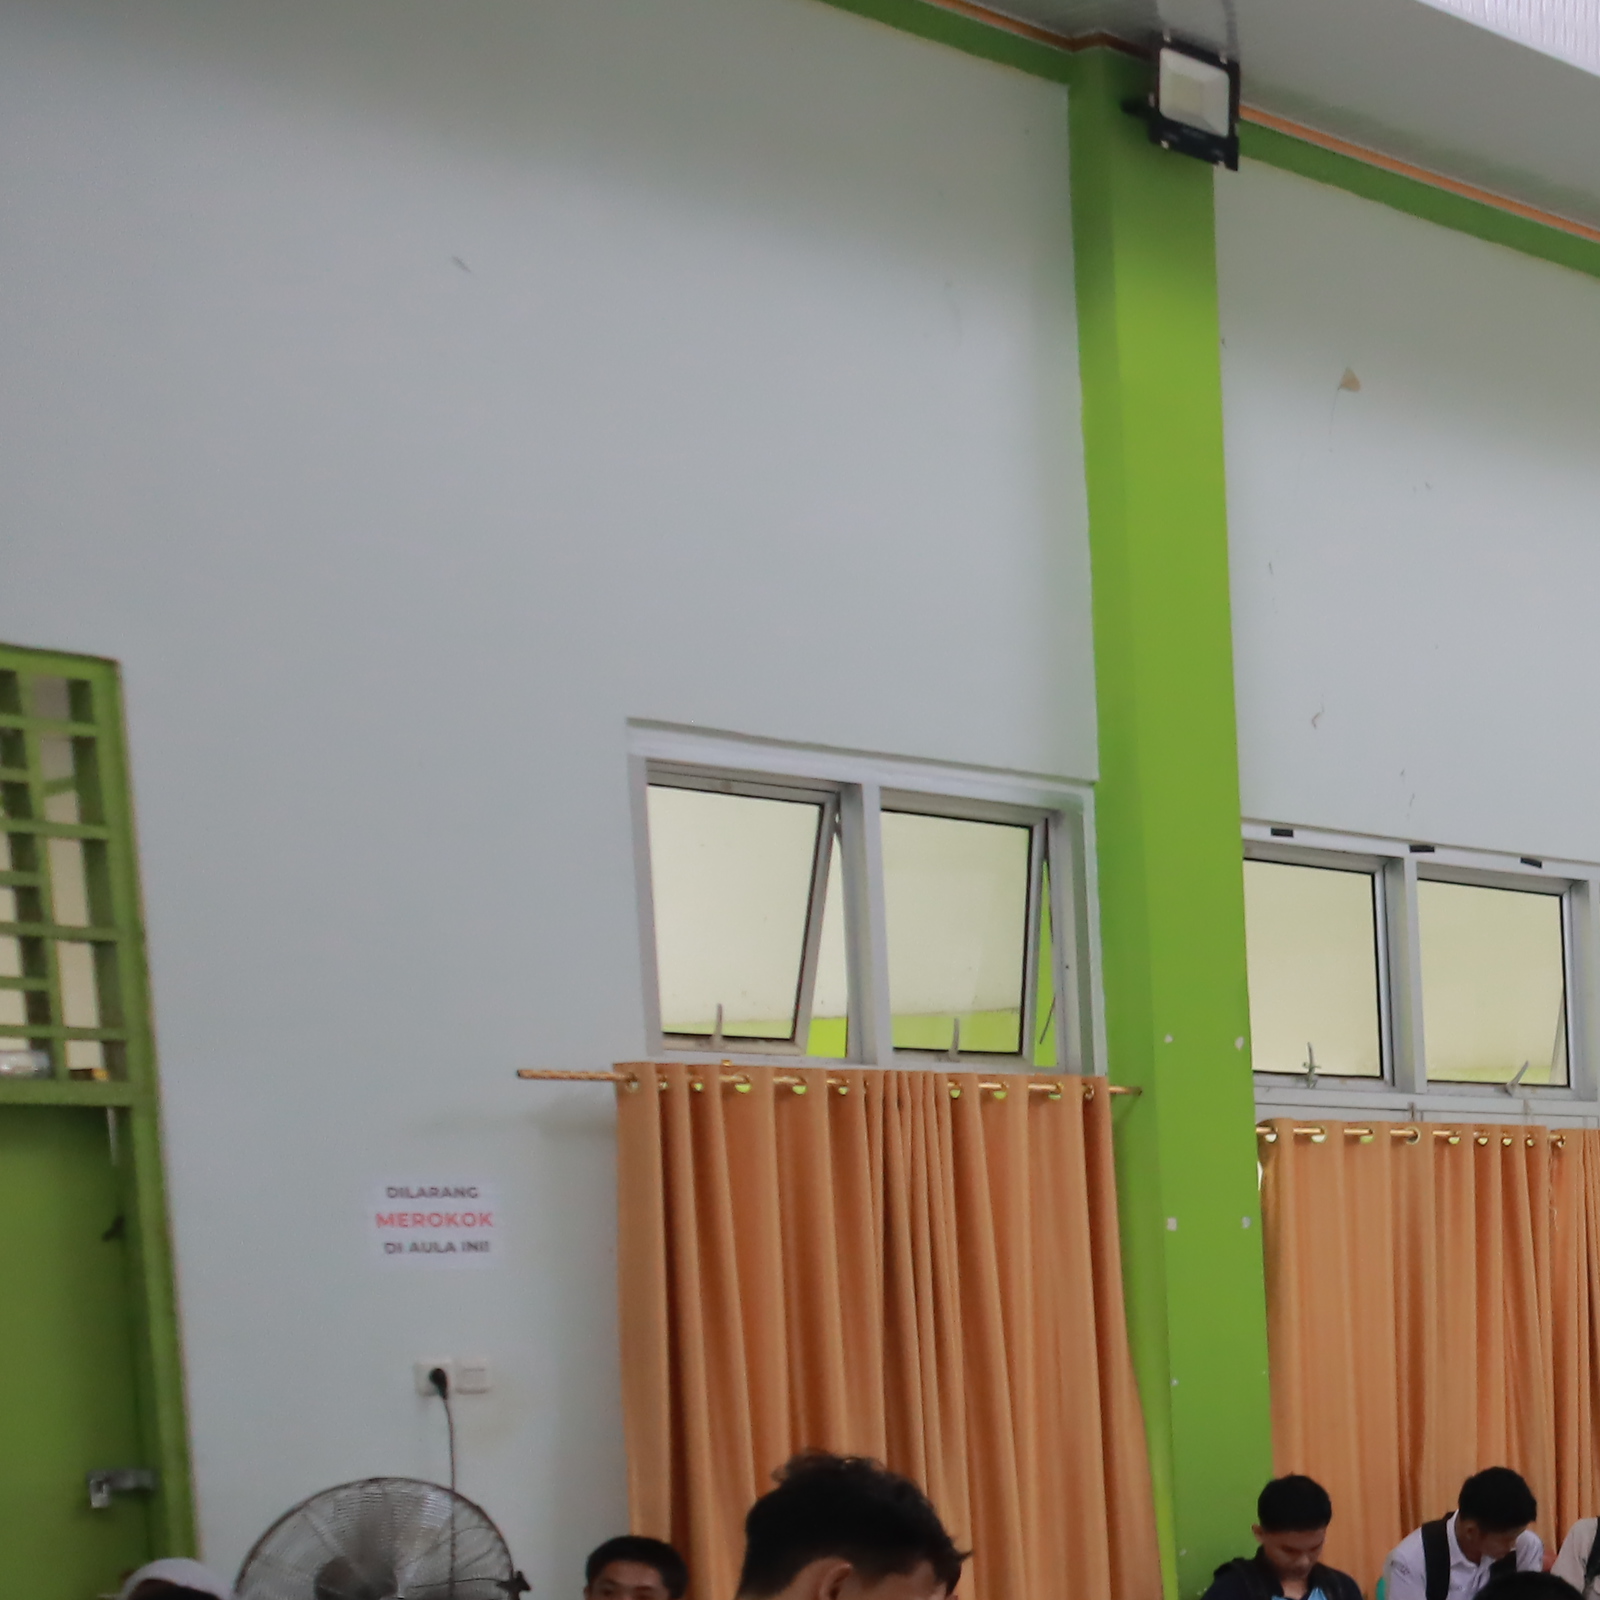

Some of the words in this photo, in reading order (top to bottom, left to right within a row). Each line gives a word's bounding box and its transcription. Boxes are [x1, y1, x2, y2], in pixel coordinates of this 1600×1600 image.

[386, 1186, 479, 1198] DILARANG
[375, 1212, 493, 1228] MEROKOK
[384, 1242, 402, 1254] DI
[409, 1241, 456, 1253] AULA
